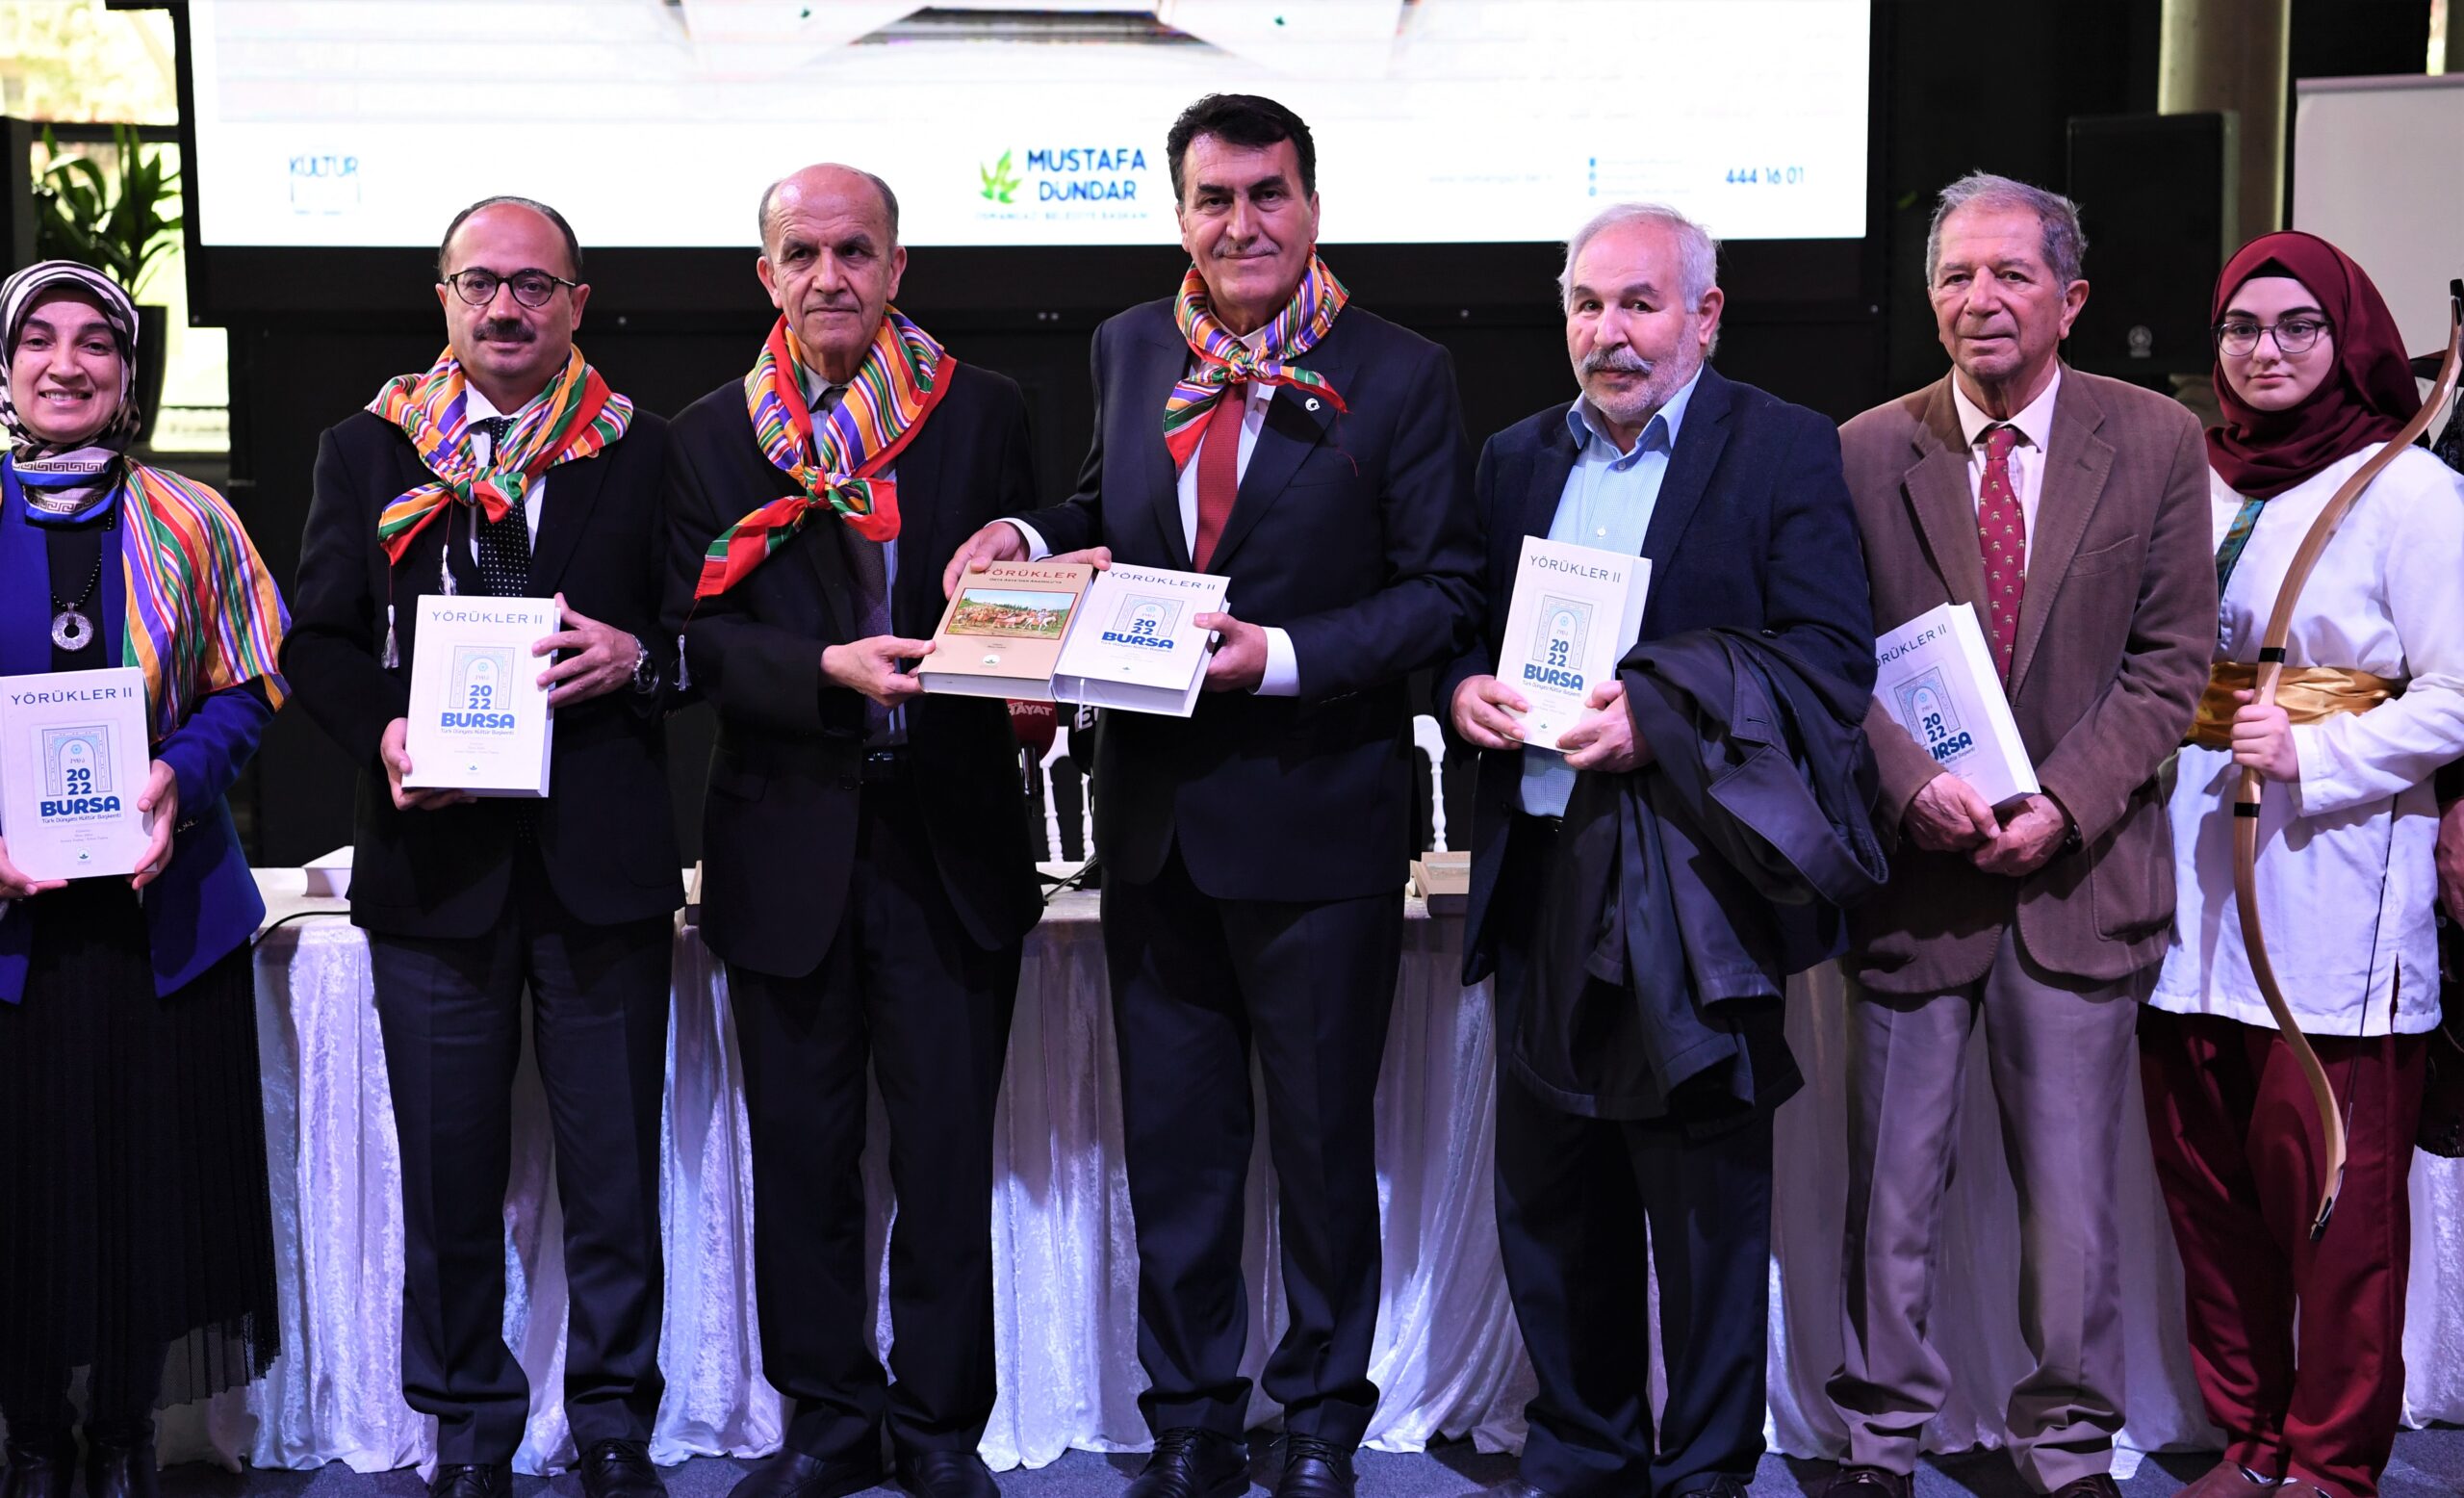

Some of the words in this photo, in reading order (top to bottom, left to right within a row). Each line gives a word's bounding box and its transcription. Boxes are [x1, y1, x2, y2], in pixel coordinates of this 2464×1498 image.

[1027, 148, 1147, 171] MUSTAFA
[1726, 168, 1758, 184] 444
[1786, 166, 1804, 185] 01
[1530, 555, 1608, 581] YÖRÜKLER
[1612, 572, 1621, 583] II
[1110, 570, 1203, 590] YÖRÜKLER
[432, 610, 527, 624] YÖRÜKLER
[534, 614, 543, 625] II
[1134, 618, 1157, 628] 20
[1131, 626, 1154, 635] 22
[1101, 632, 1174, 649] BURSA
[1551, 639, 1569, 654] 20
[1876, 630, 1936, 668] RÜKLER
[1548, 652, 1567, 667] 22
[1524, 663, 1584, 690] BURSA
[12, 687, 116, 706] YÖRÜKLER
[122, 686, 133, 698] II
[470, 684, 493, 697] 20
[469, 697, 491, 710] 22
[441, 712, 515, 729] BURSA
[1922, 712, 1941, 730] 20
[1927, 725, 1947, 743] 22
[66, 767, 90, 782] 20
[67, 782, 92, 796] 22
[40, 796, 121, 817] BURSA
